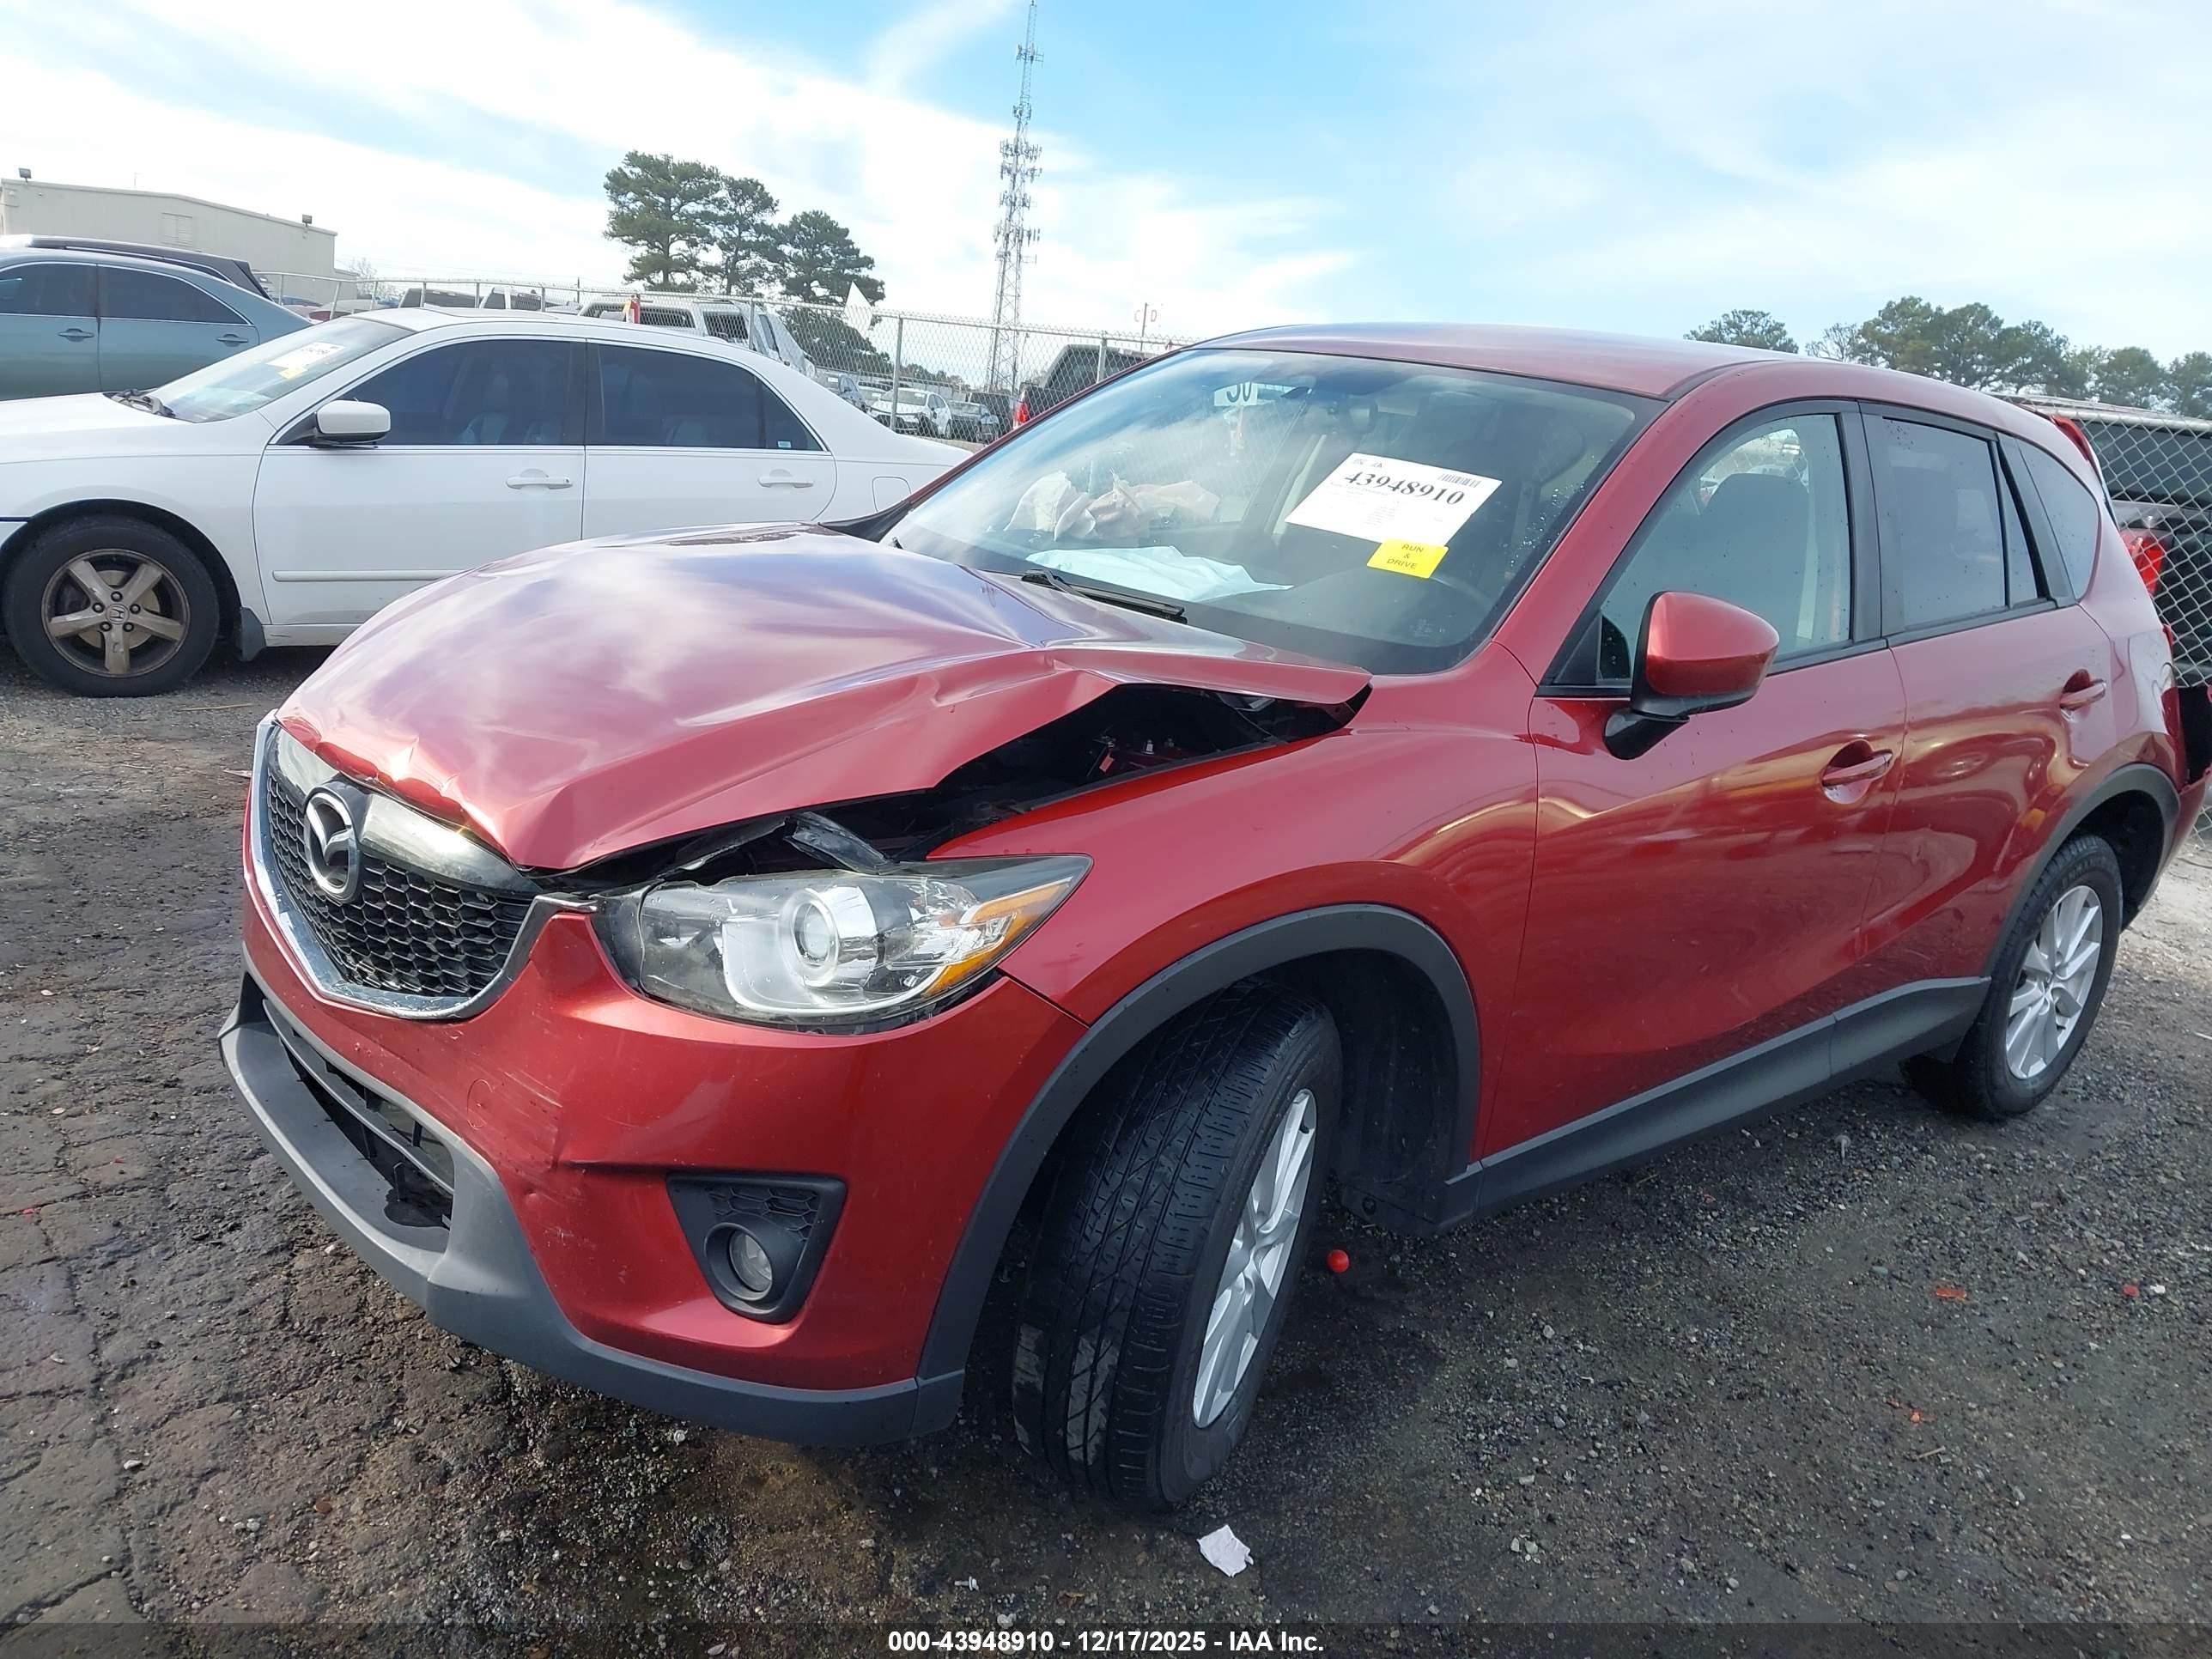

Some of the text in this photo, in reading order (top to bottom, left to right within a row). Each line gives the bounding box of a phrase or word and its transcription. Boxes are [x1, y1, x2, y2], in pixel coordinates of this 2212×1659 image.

[1345, 471, 1466, 505] 43948910
[1401, 544, 1424, 553] RUN
[1387, 558, 1419, 569] DRIVE
